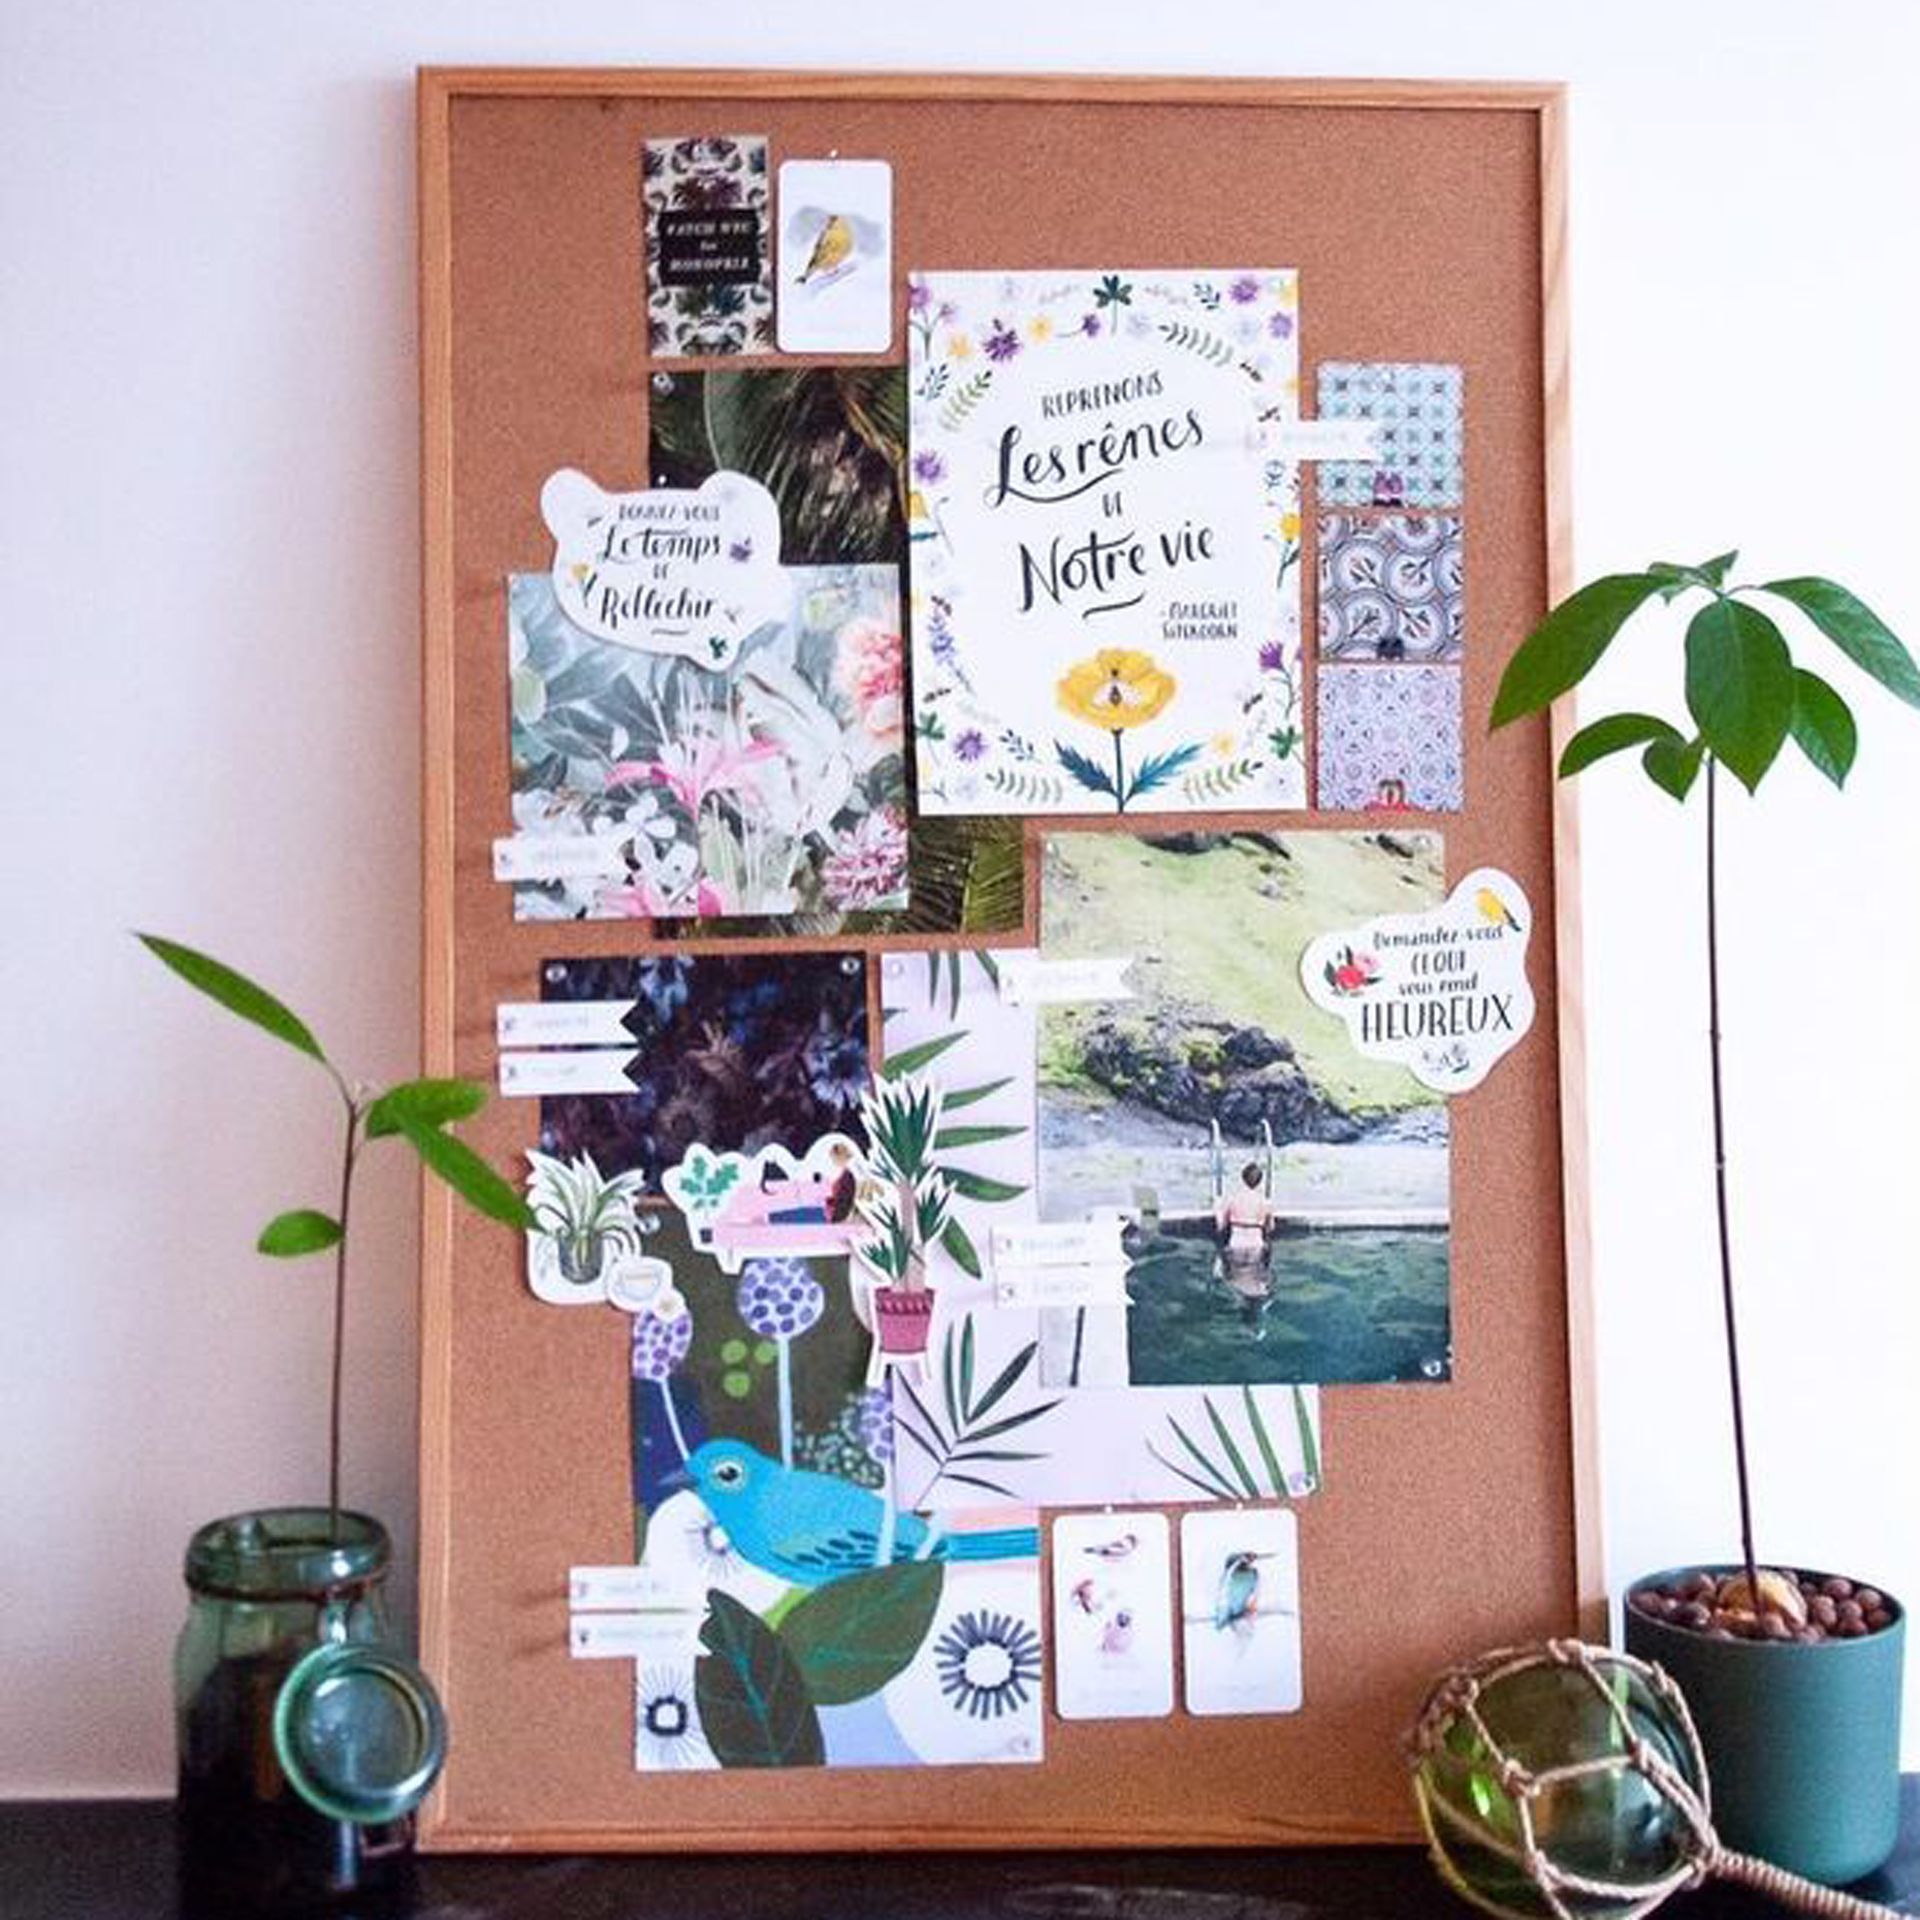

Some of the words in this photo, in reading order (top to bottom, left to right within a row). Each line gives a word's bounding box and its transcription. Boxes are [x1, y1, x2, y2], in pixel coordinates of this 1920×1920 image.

[1042, 371, 1164, 418] REPRENONS
[1019, 531, 1146, 612] Notre
[1160, 520, 1213, 567] vie
[1361, 993, 1514, 1043] HEUREUX
